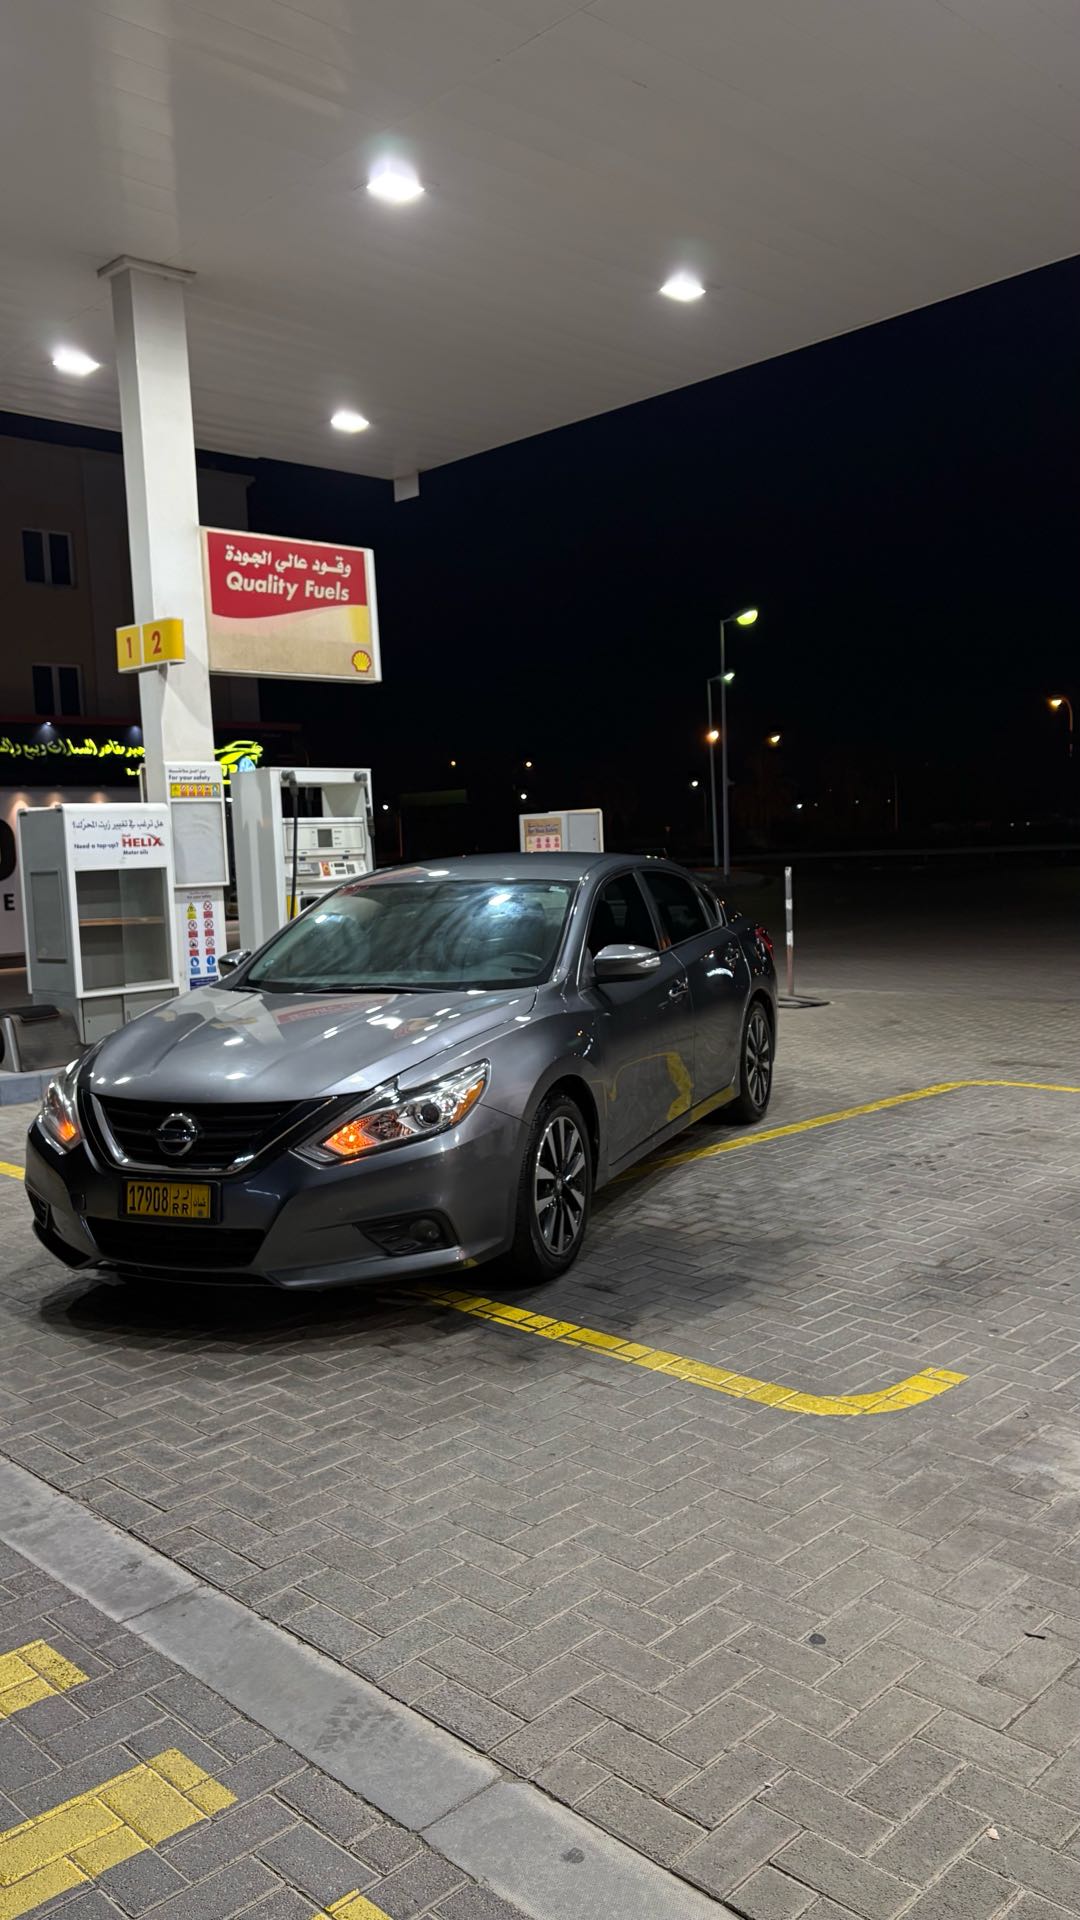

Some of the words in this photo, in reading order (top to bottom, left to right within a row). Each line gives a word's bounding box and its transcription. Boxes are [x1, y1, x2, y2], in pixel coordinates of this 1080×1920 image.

[225, 545, 272, 568] الجودة
[275, 554, 308, 573] عالي
[312, 556, 352, 578] وقود
[226, 571, 299, 600] Quality
[305, 580, 350, 601] Fuels
[126, 636, 133, 659] 1
[151, 630, 162, 655] 2
[96, 842, 119, 850] top-up?
[121, 835, 163, 848] HELIX
[129, 1185, 169, 1213] 17908
